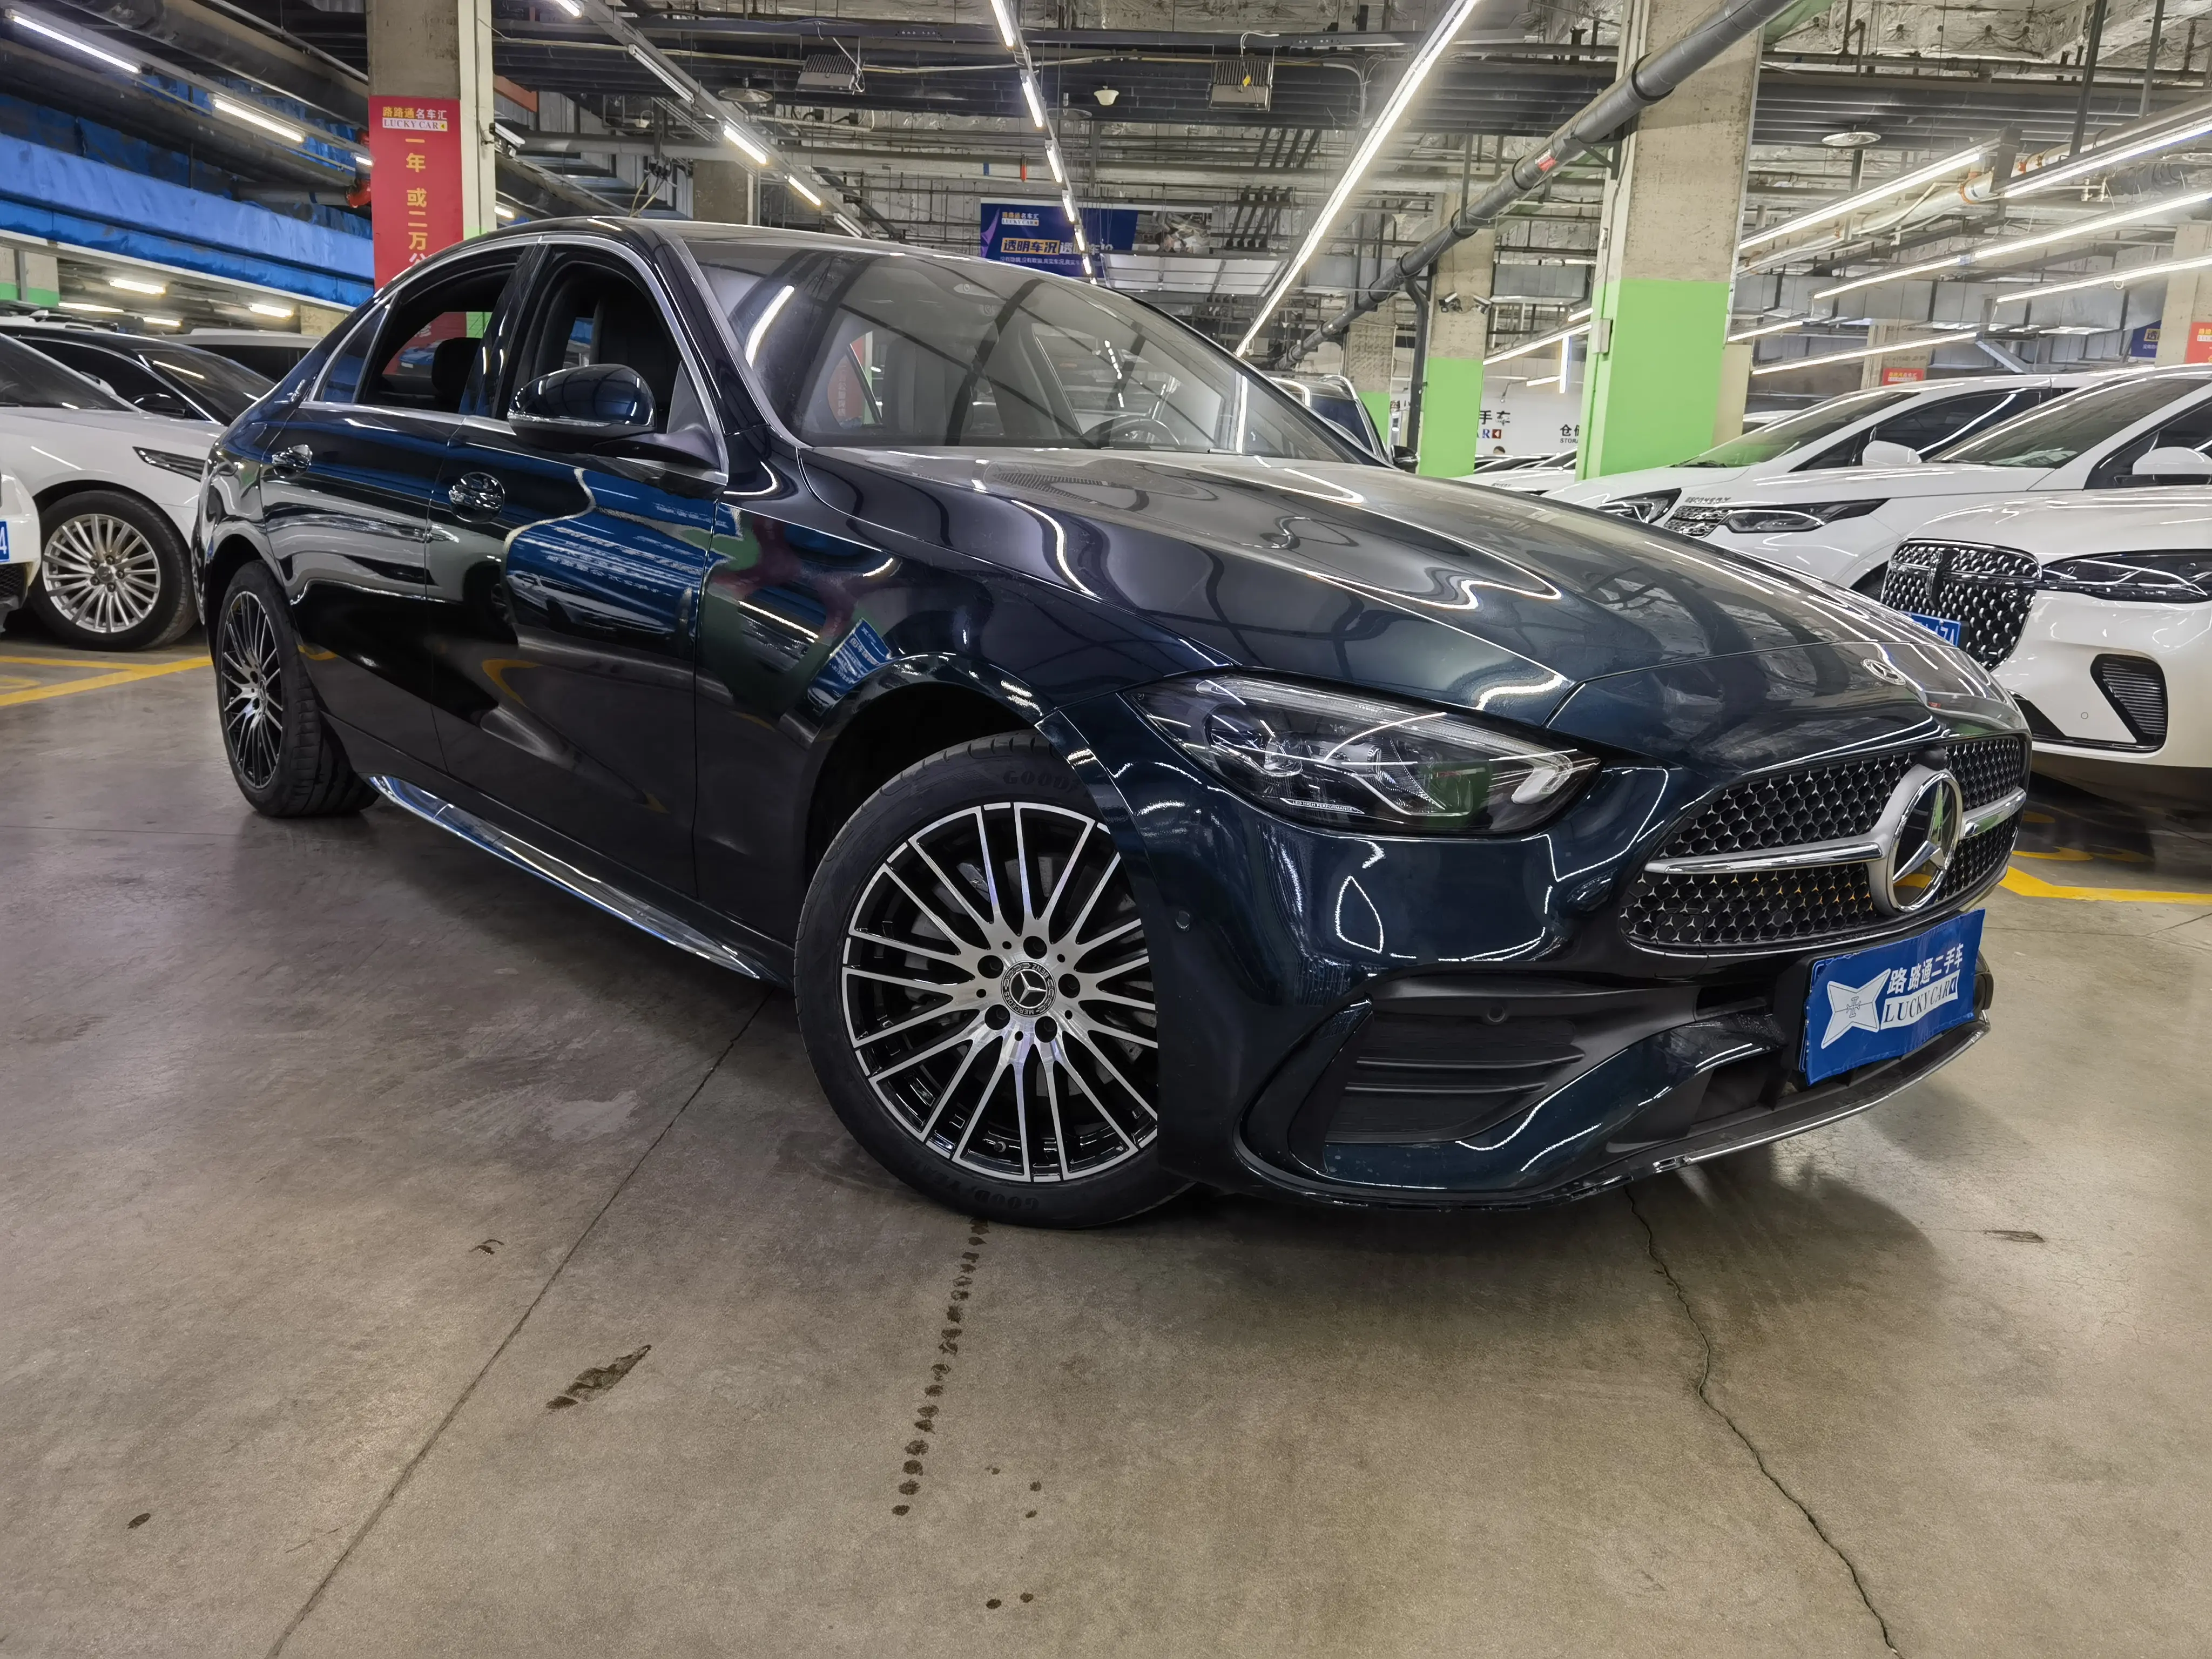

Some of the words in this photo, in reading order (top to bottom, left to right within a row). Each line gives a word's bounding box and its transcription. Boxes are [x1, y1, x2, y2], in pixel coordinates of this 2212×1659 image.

[383, 107, 447, 120] 路路通名车汇
[384, 119, 415, 127] LUCKY
[419, 121, 439, 129] CAR
[1003, 239, 1057, 253] 透明车况
[1317, 804, 1353, 812] PERFORMANCE
[1032, 963, 1049, 979] BENZ
[1886, 943, 1964, 995] 路路通二手车
[1004, 991, 1034, 1015] MERCEDES
[1883, 990, 1930, 1023] LUCKY
[1930, 980, 1951, 1005] CAR
